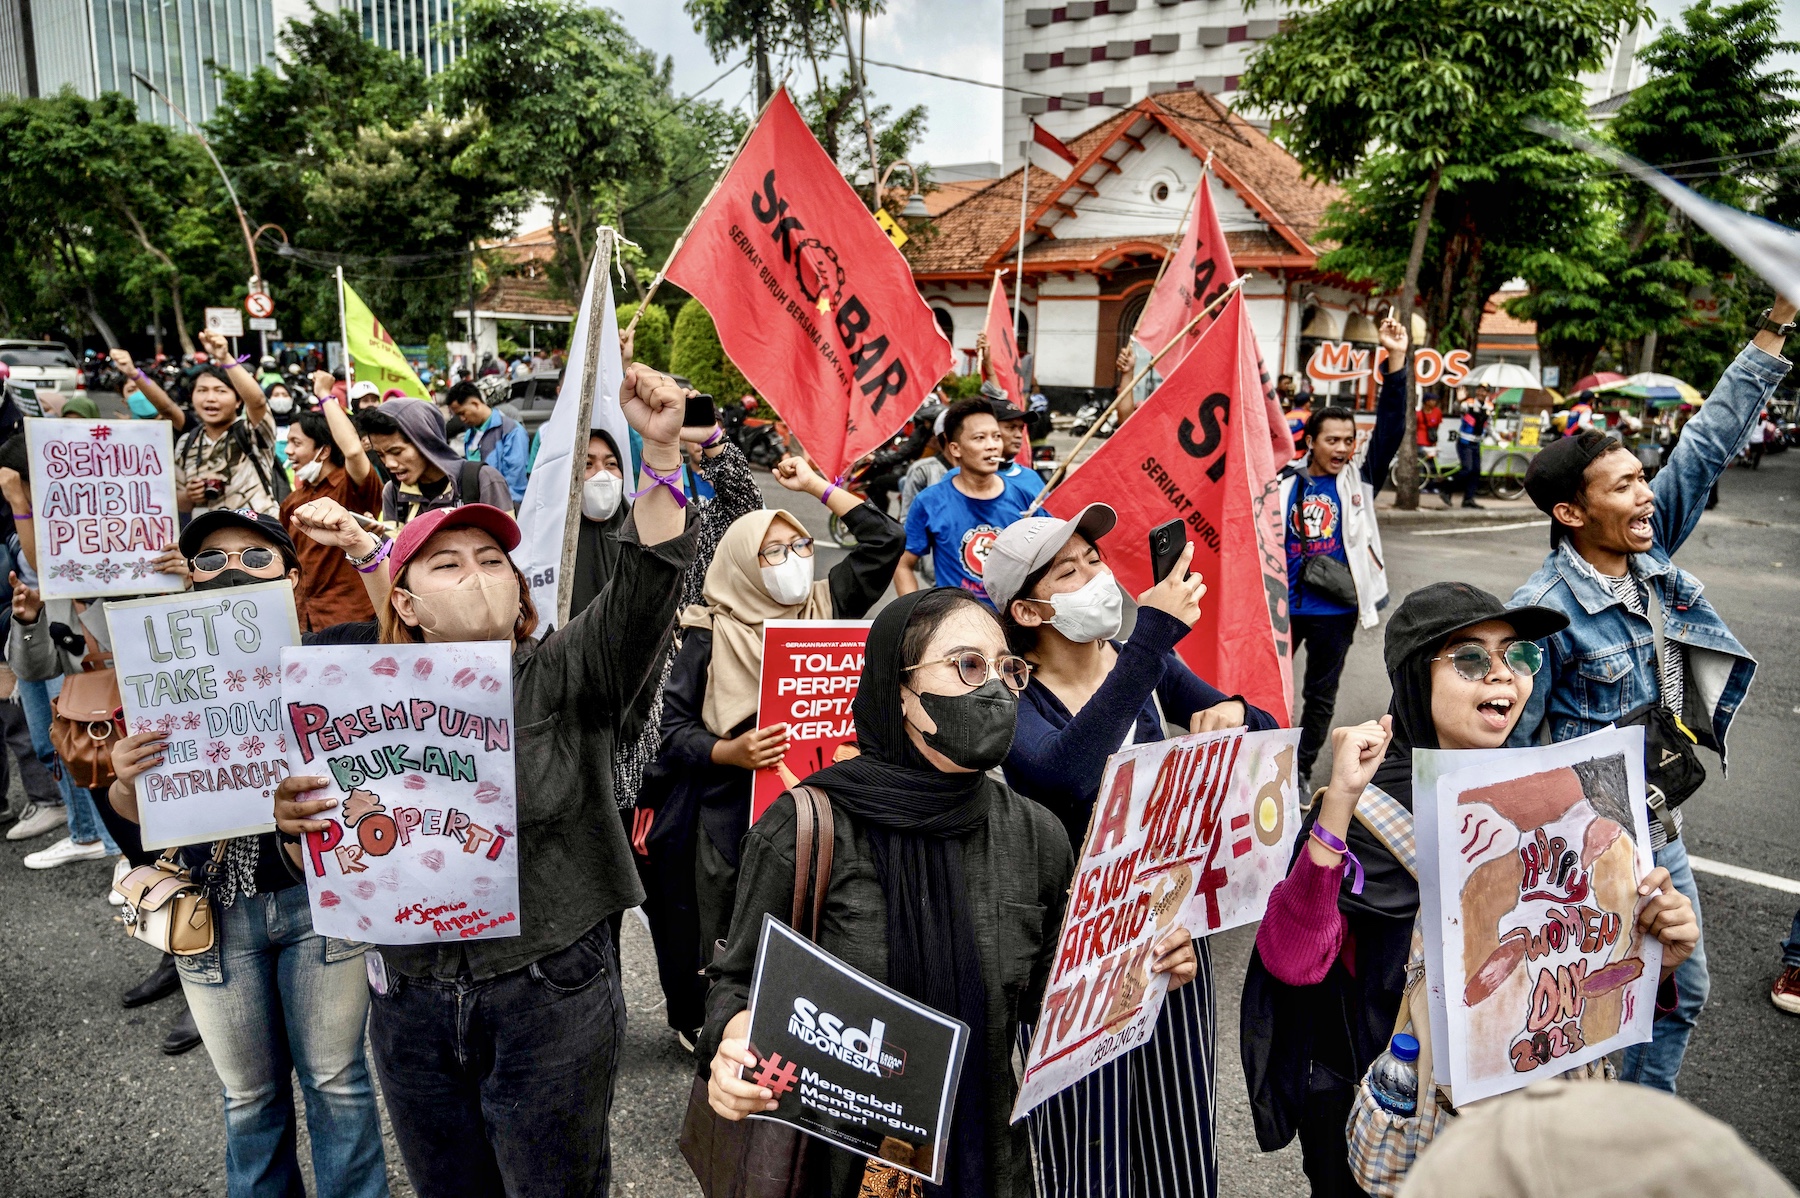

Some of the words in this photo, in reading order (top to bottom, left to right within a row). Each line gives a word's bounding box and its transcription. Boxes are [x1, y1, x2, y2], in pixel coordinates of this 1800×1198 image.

[728, 224, 763, 270] SERIKAT
[758, 265, 788, 306] BURUH
[785, 301, 821, 349] BERSAMA
[819, 341, 848, 387] RAKYAT
[43, 440, 162, 479] SEMUA
[1141, 456, 1192, 513] SERIKAT
[42, 481, 162, 518] AMBIL
[49, 516, 173, 555] PERAN
[144, 599, 262, 663] LET'S
[125, 665, 218, 708] TAKE
[778, 676, 861, 696] PERPP
[204, 696, 284, 738] DOW
[288, 698, 510, 764] PEREMPUAN
[327, 745, 478, 792] BUKAN
[1090, 758, 1135, 857] A
[1139, 735, 1243, 867] QUEEN
[1071, 866, 1101, 920] IS
[1096, 848, 1141, 914] NOT
[1054, 891, 1151, 985] AFRAID
[1500, 905, 1622, 962] WOMEN
[1039, 974, 1087, 1059] TO
[1527, 958, 1588, 1032] DAY
[787, 1017, 882, 1078] INDONESIA
[1510, 1021, 1587, 1073] 2023
[800, 1083, 928, 1137] Membangun
[801, 1066, 903, 1116] Mengabdi
[801, 1096, 868, 1126] Negeri
